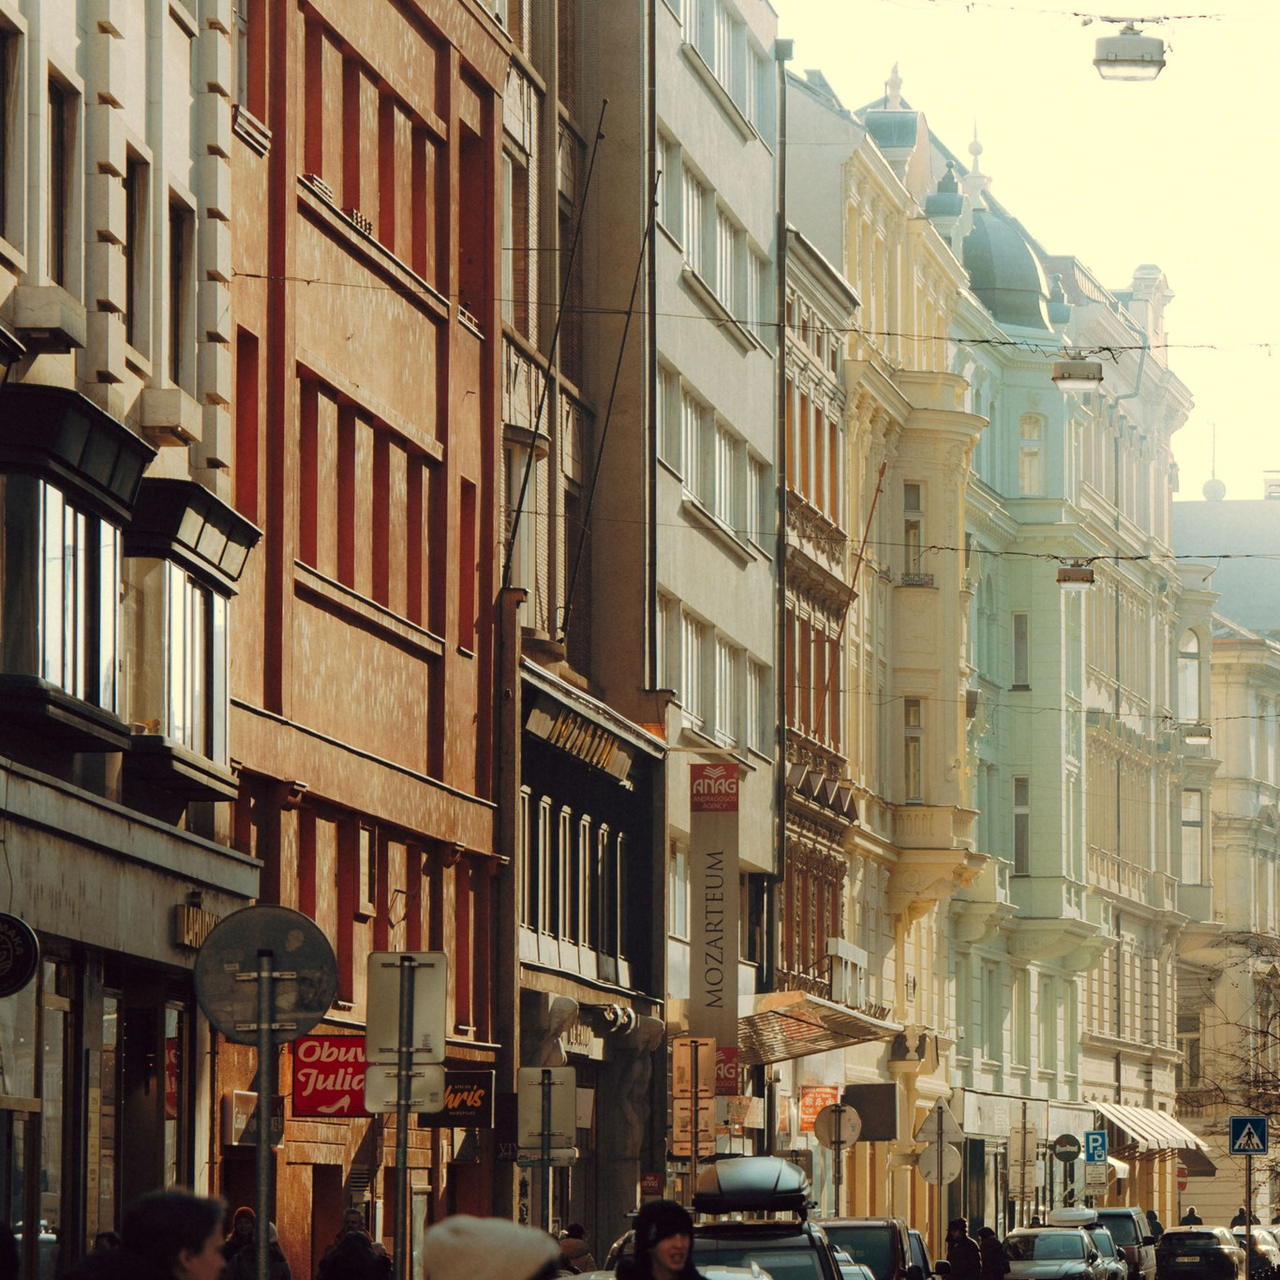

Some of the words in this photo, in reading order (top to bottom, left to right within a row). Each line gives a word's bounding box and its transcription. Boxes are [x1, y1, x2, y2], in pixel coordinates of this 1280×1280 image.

[692, 778, 737, 794] ANAG
[705, 850, 724, 1009] MOZARTEUM
[297, 1040, 366, 1063] Obuv
[297, 1066, 366, 1097] Julia
[443, 1084, 486, 1109] hris
[1089, 1135, 1102, 1153] P
